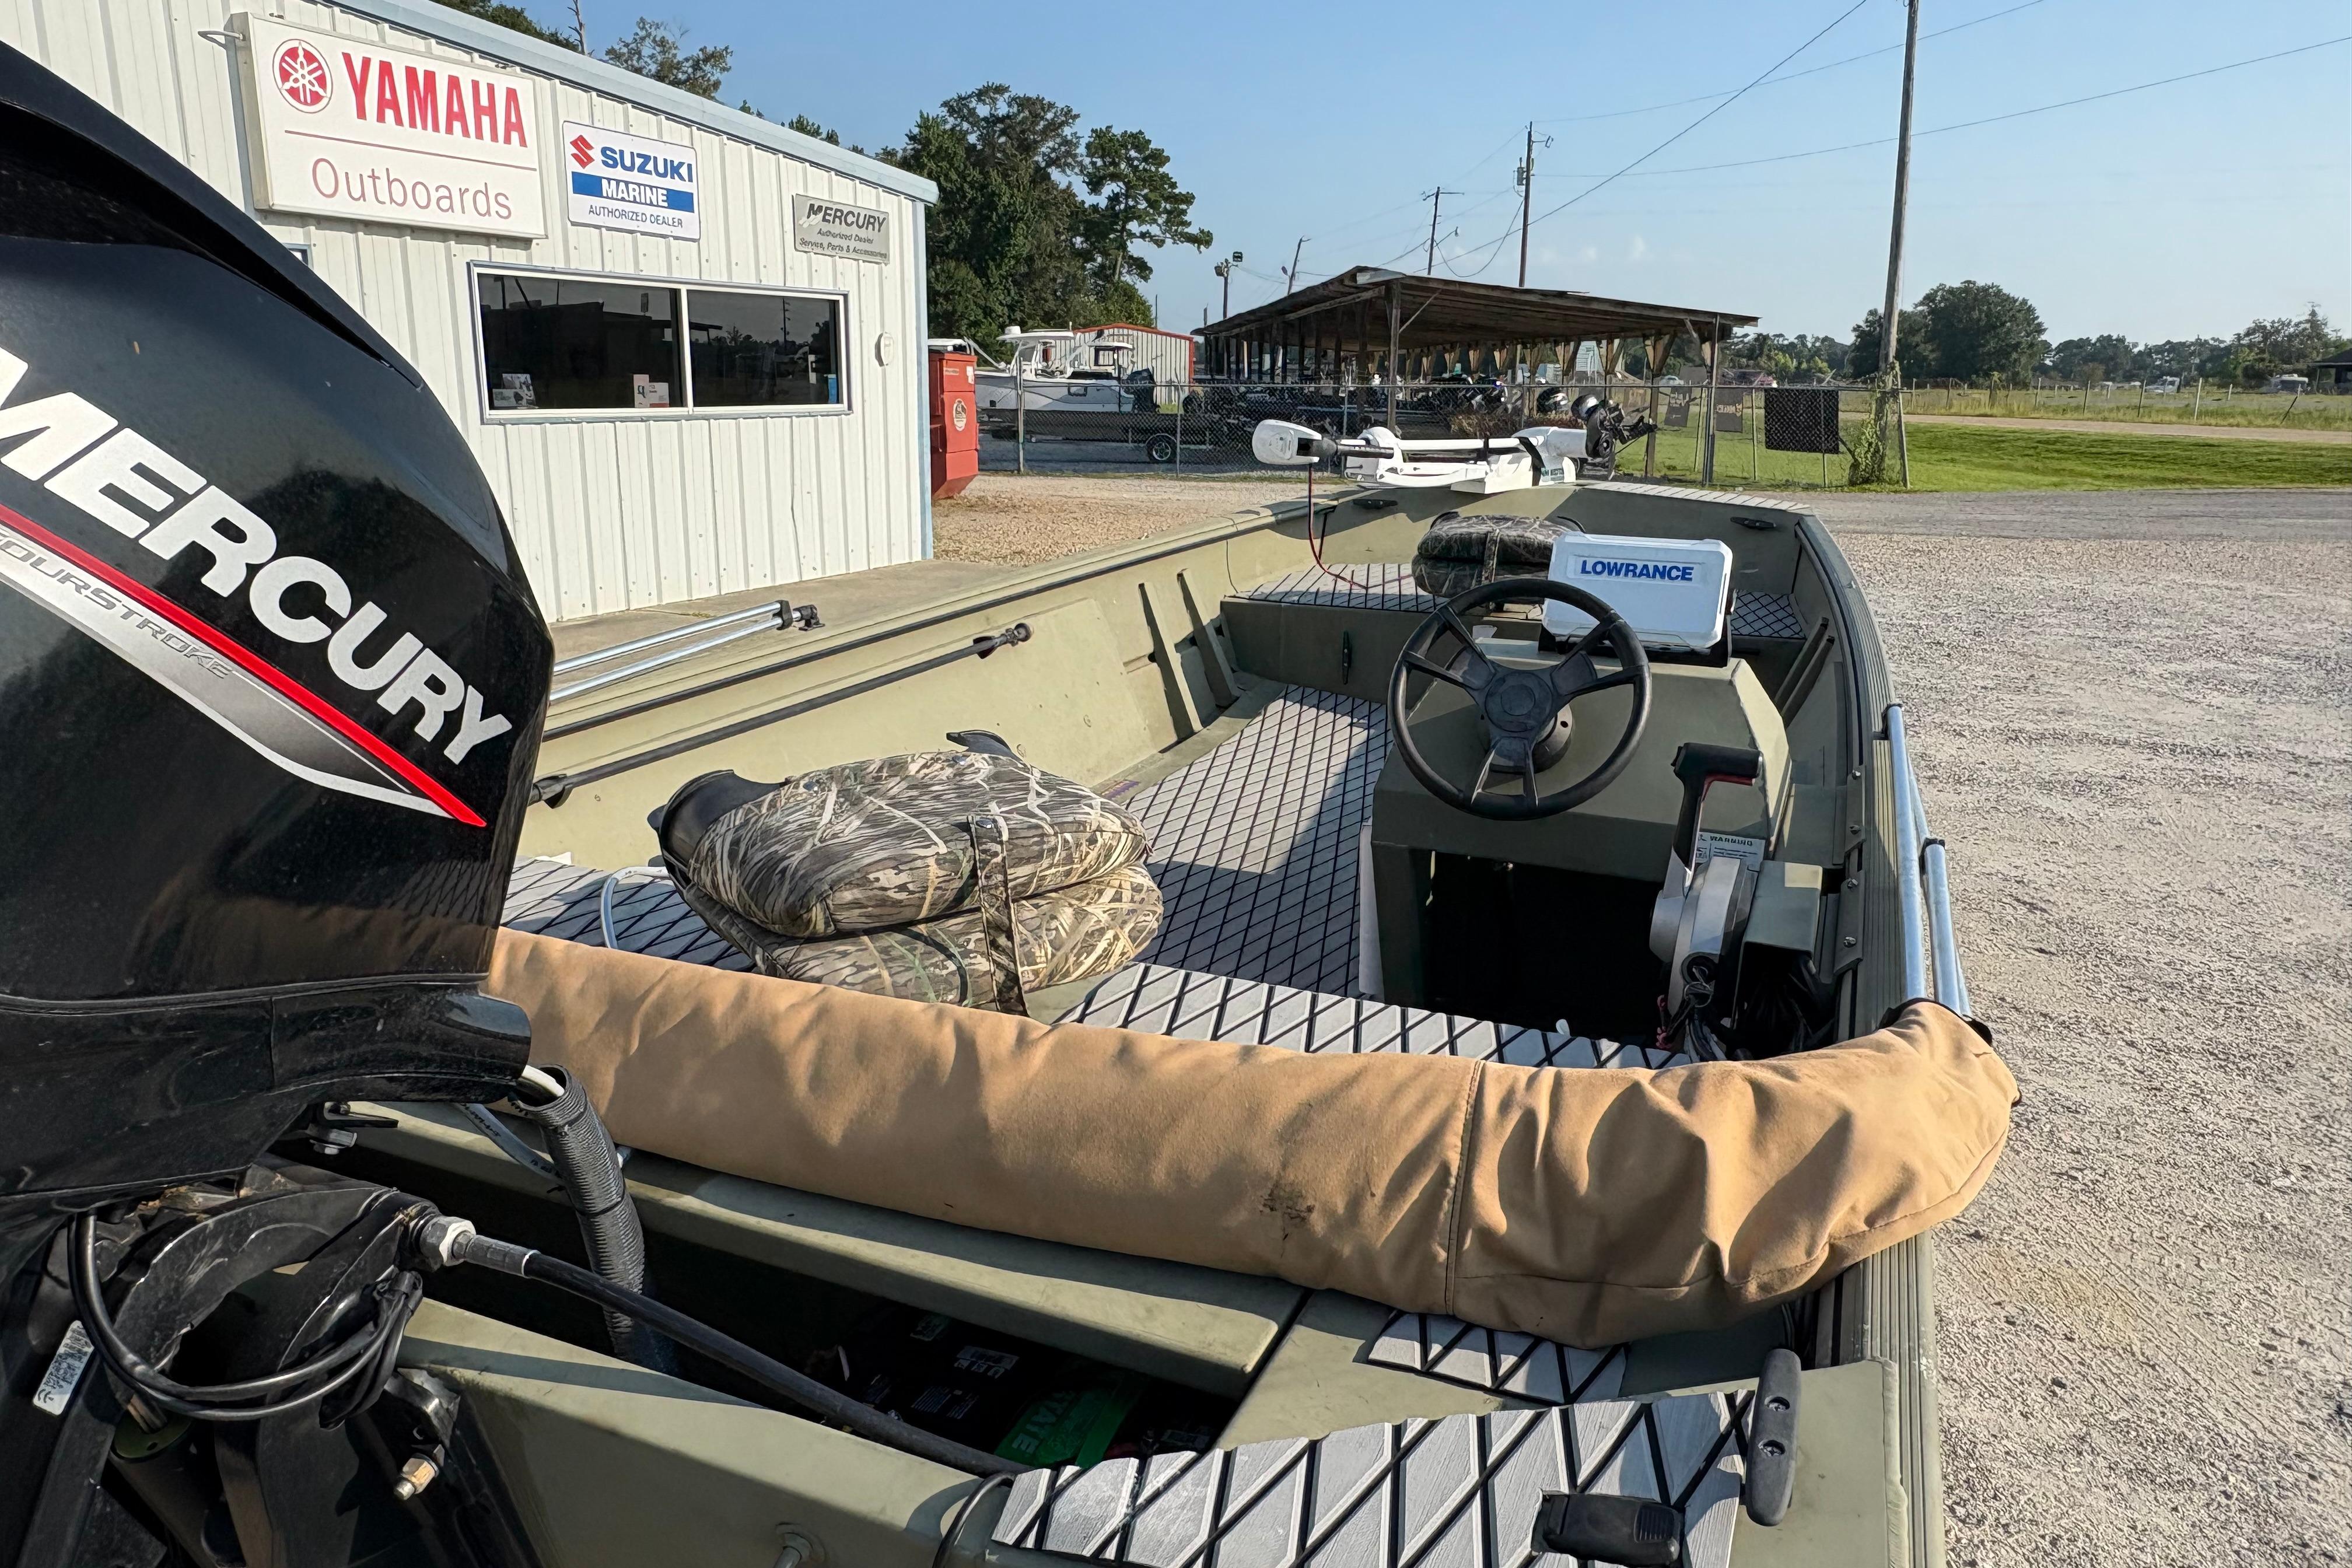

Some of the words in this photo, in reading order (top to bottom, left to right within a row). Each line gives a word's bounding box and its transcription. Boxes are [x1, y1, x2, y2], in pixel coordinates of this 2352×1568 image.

[341, 52, 527, 148] YAMAHA
[600, 146, 694, 183] SUZUKI
[312, 158, 512, 220] Outboards
[601, 178, 668, 207] MARINE
[589, 205, 647, 223] AUTHORIZED
[650, 214, 683, 228] DEALER
[807, 203, 887, 233] MERCURY
[817, 228, 853, 241] Authorized
[854, 234, 874, 244] Dealer
[827, 242, 844, 252] Parts
[1580, 559, 1694, 582] LOWRANCE
[0, 527, 233, 678] OURSTROKE
